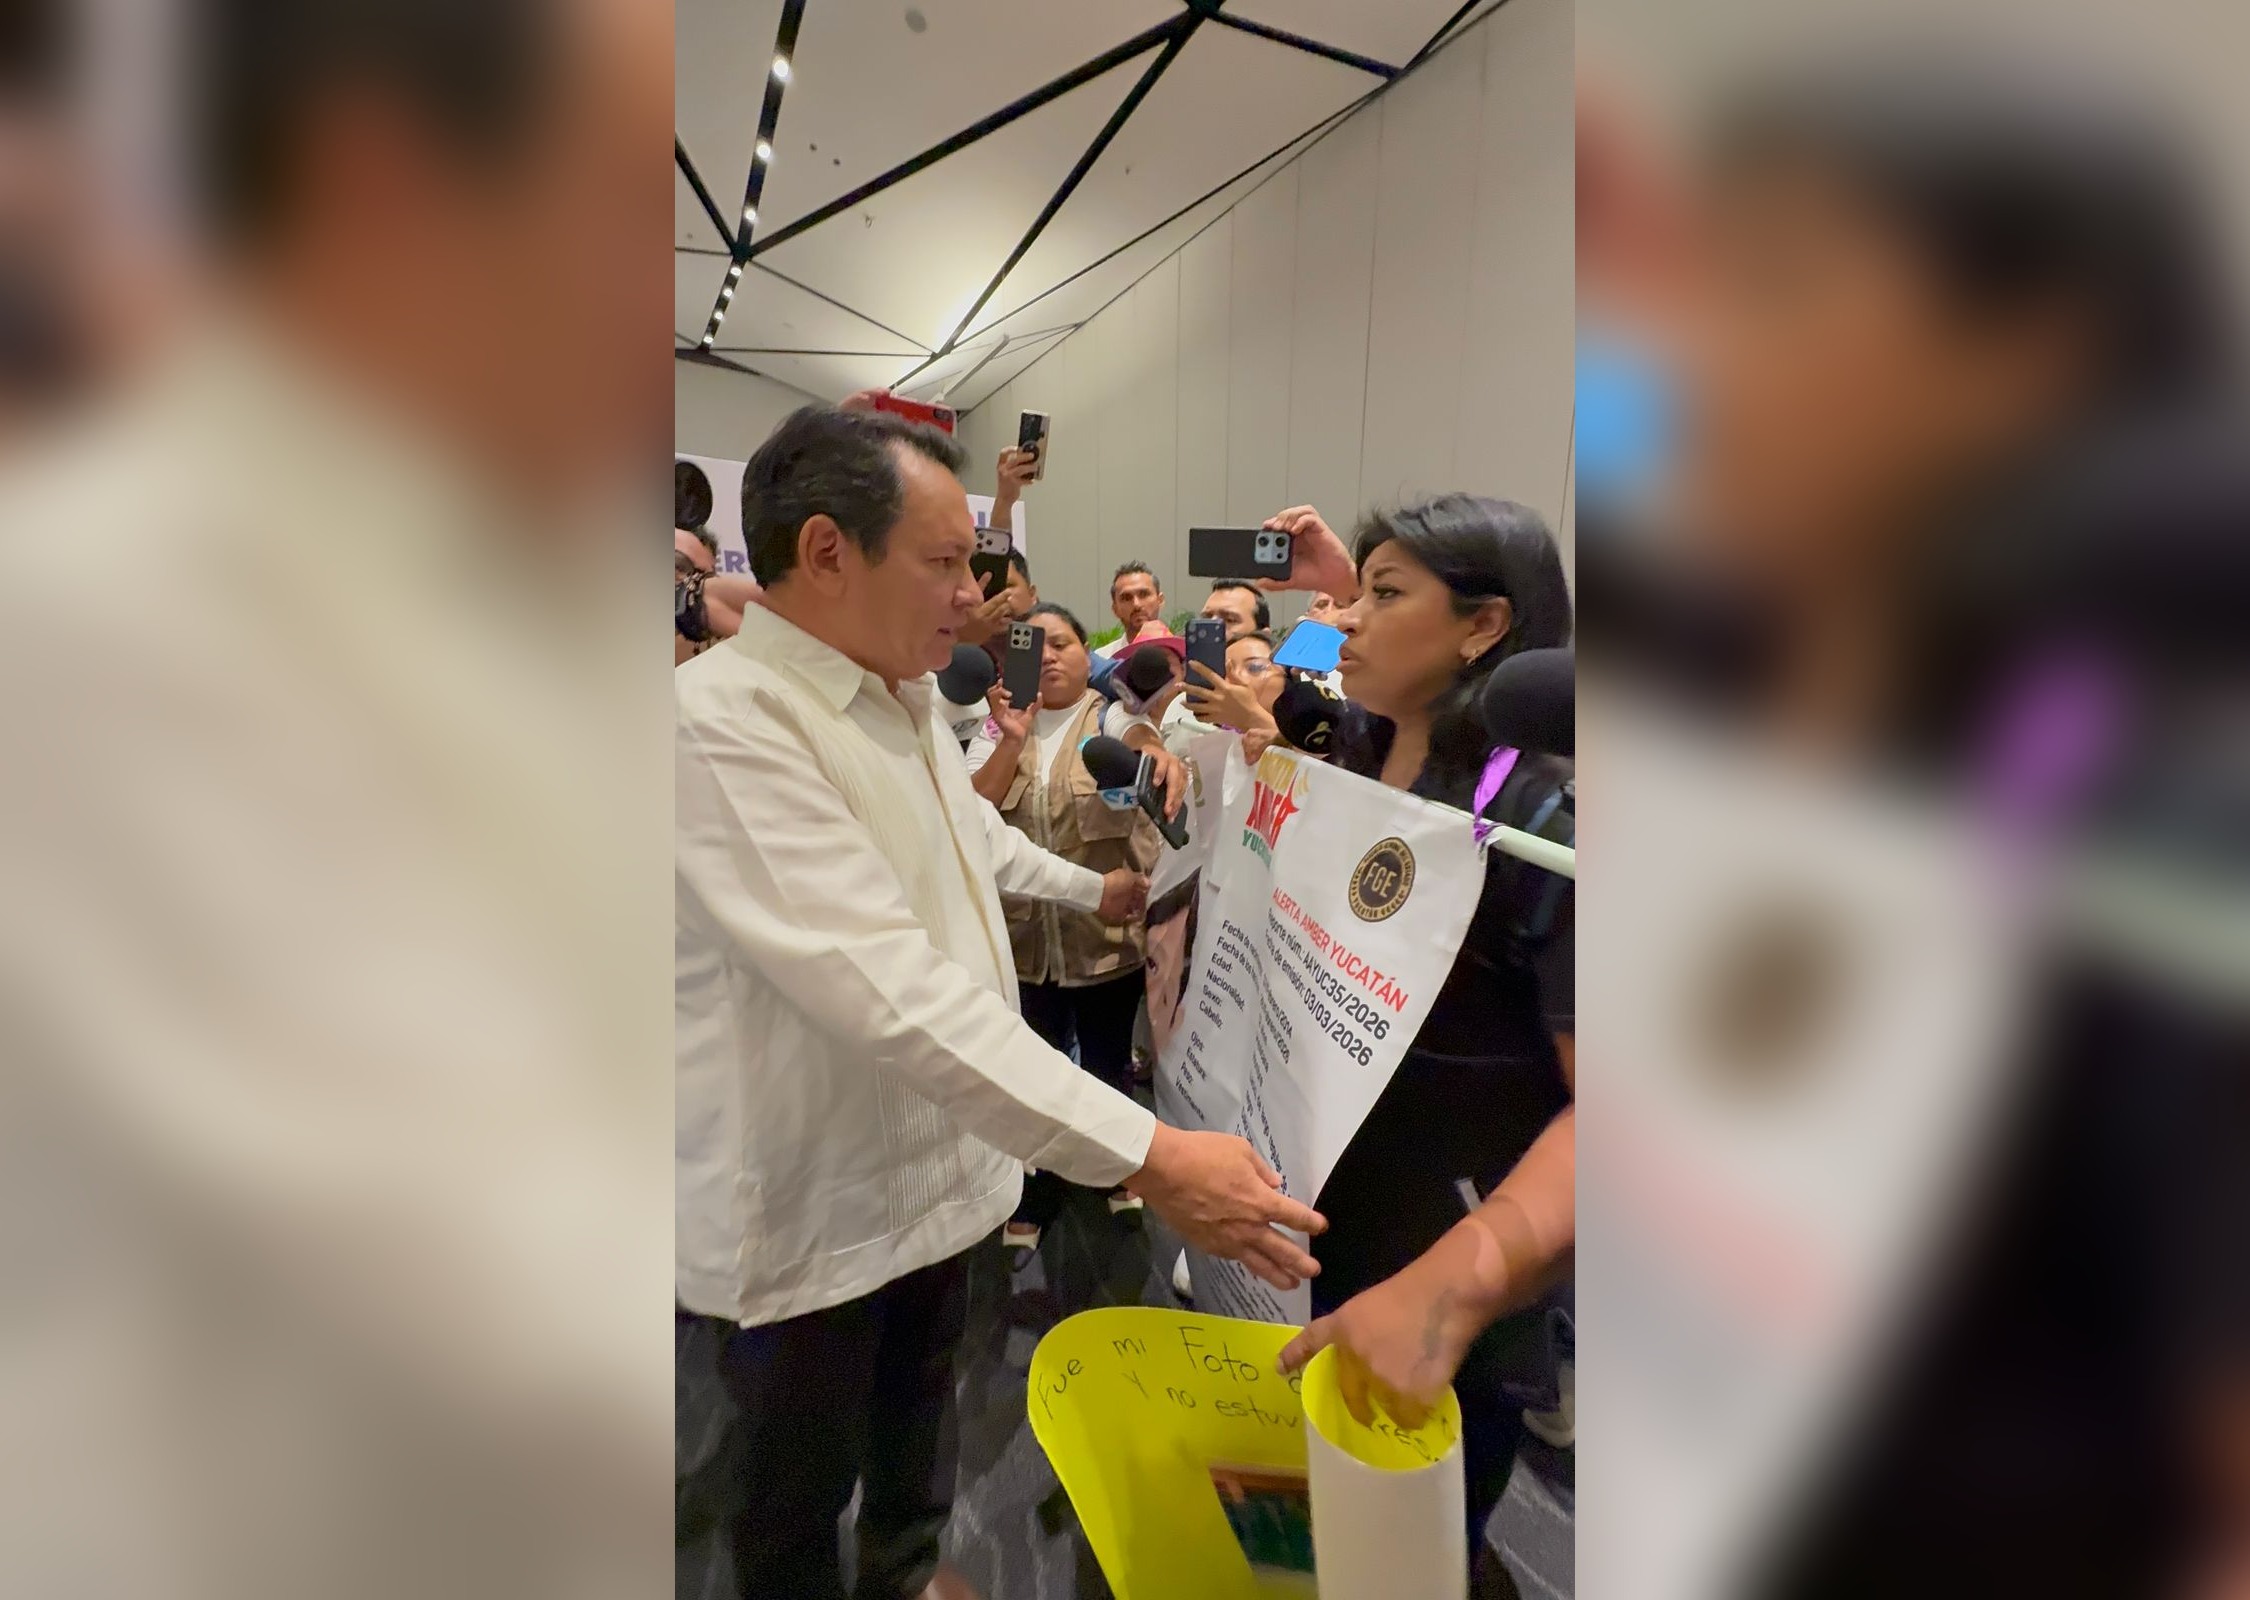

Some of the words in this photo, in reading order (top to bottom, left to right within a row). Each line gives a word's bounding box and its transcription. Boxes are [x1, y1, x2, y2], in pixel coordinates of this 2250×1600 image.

[1363, 862, 1398, 898] FGE
[1217, 936, 1239, 960] Fecha
[1222, 920, 1244, 942] Fecha
[1211, 953, 1233, 974] Edad:
[1272, 887, 1300, 923] ALERTA
[1300, 914, 1330, 952] AMBER
[1329, 940, 1408, 1012] YUCATÁN
[1303, 952, 1390, 1040] AAYUC35/2026
[1303, 988, 1373, 1067] 03/03/2026
[1179, 1326, 1258, 1383] Foto
[1166, 1387, 1196, 1409] no
